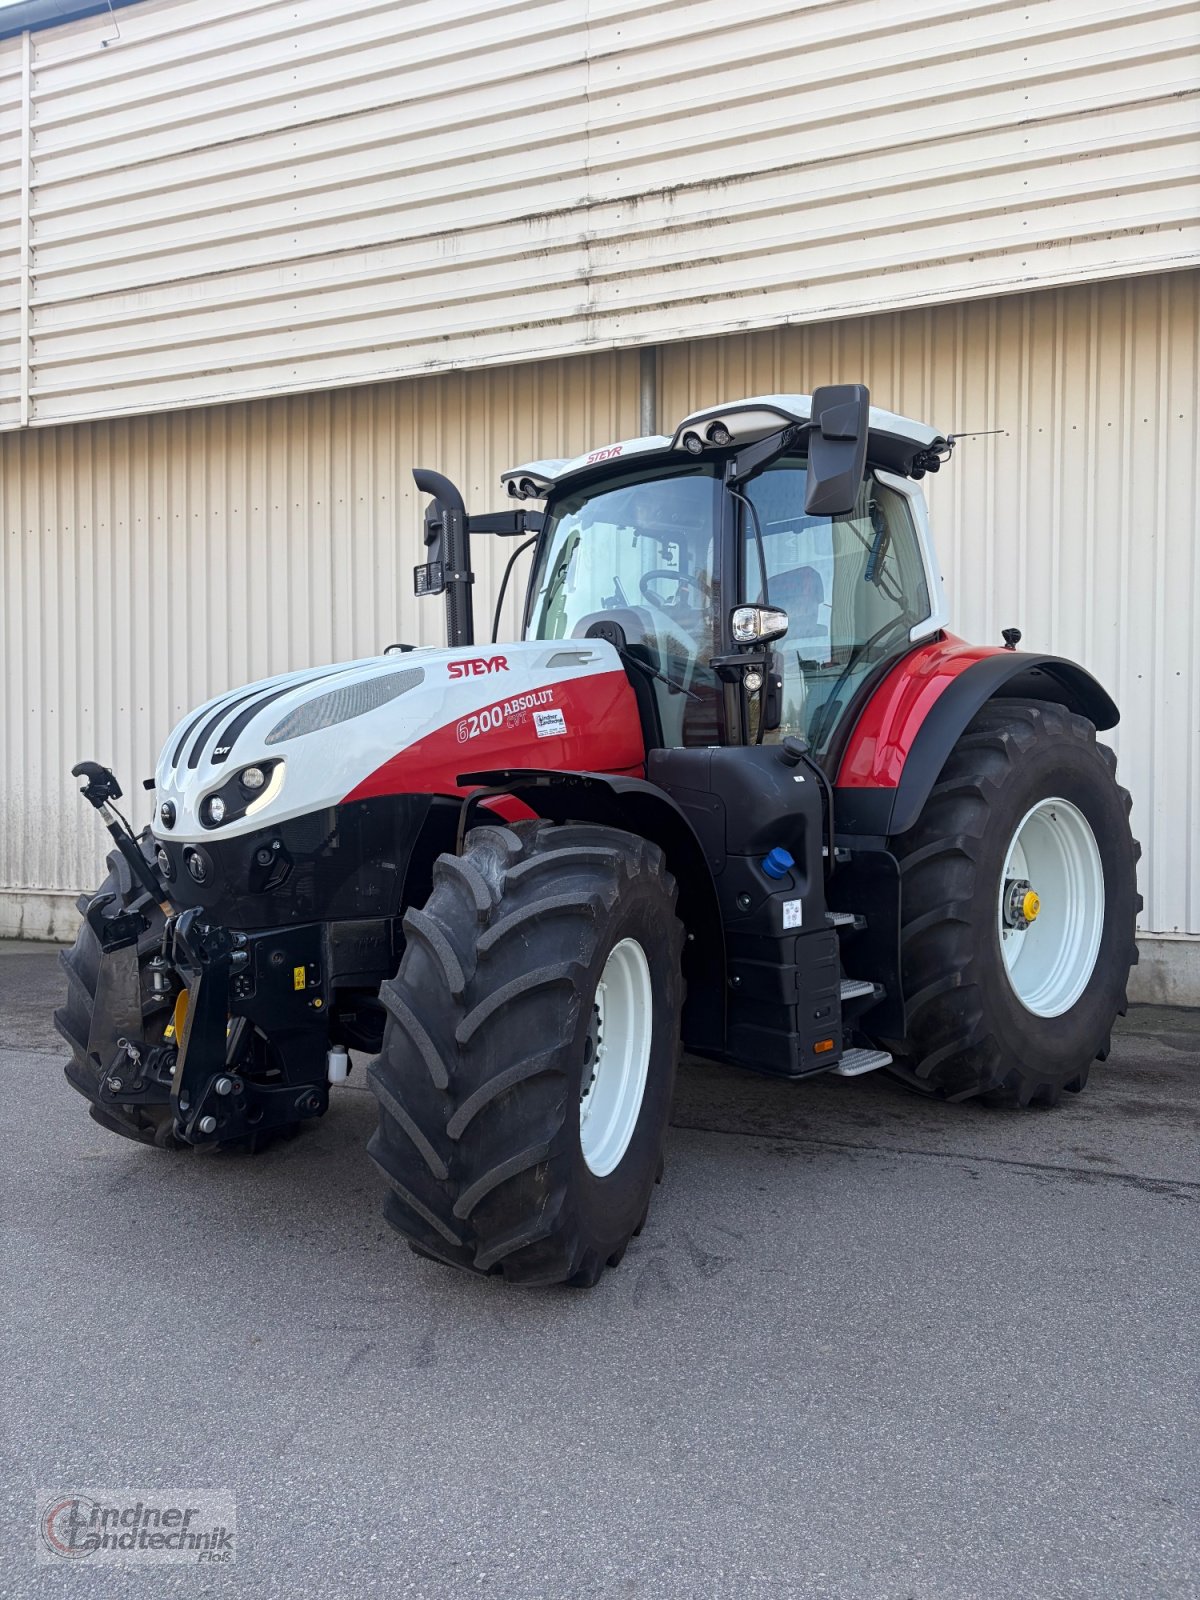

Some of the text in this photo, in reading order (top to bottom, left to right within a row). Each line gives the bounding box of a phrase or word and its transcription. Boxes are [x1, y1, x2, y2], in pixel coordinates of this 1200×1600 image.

[586, 446, 623, 464] STEYR
[447, 656, 510, 679] STEYR
[457, 690, 553, 743] 6200 ABSOLUT
[506, 711, 527, 729] CVT
[214, 746, 231, 755] CVT
